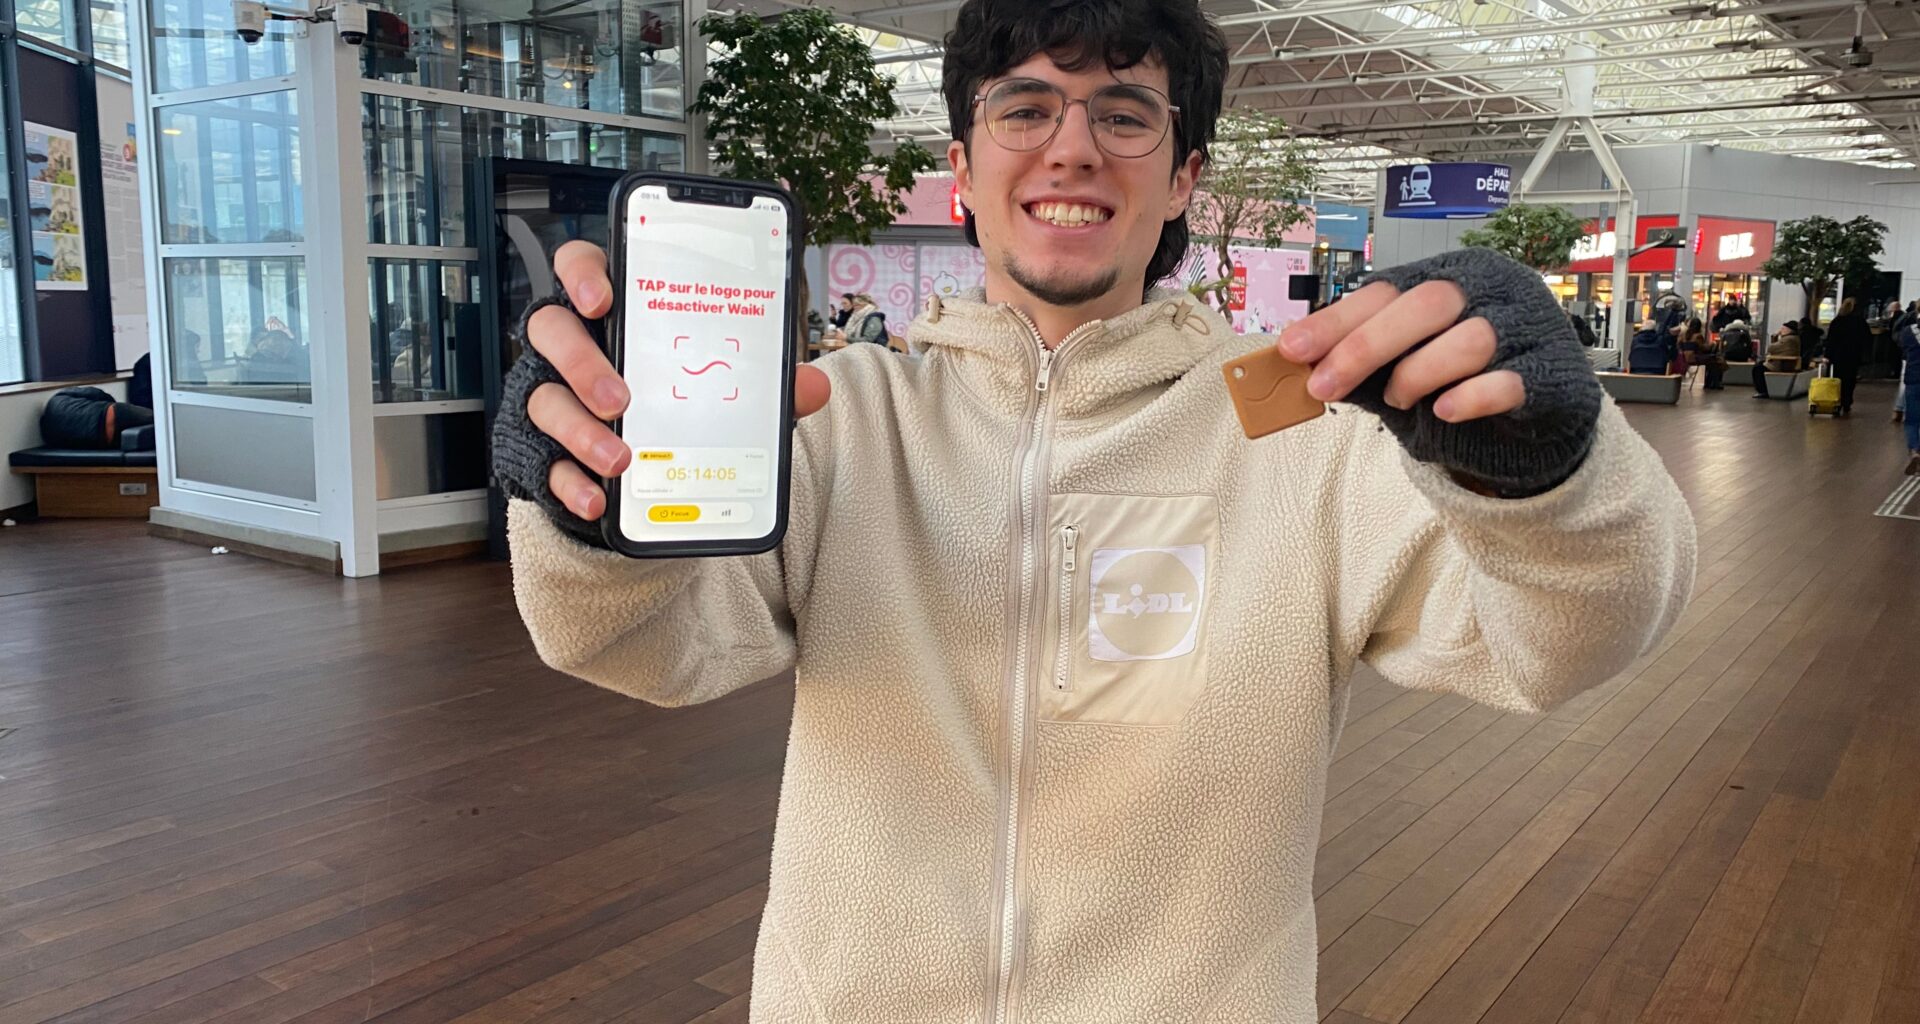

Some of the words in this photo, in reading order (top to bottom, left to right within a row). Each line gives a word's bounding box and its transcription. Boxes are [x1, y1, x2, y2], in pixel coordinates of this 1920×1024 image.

[1494, 168, 1509, 177] HALL
[637, 279, 666, 292] TAP
[668, 283, 692, 294] sur
[695, 283, 708, 295] le
[710, 284, 741, 299] logo
[744, 288, 776, 301] pour
[647, 299, 724, 314] désactiver
[728, 303, 765, 316] Waiki
[666, 467, 737, 481] 05:14:05
